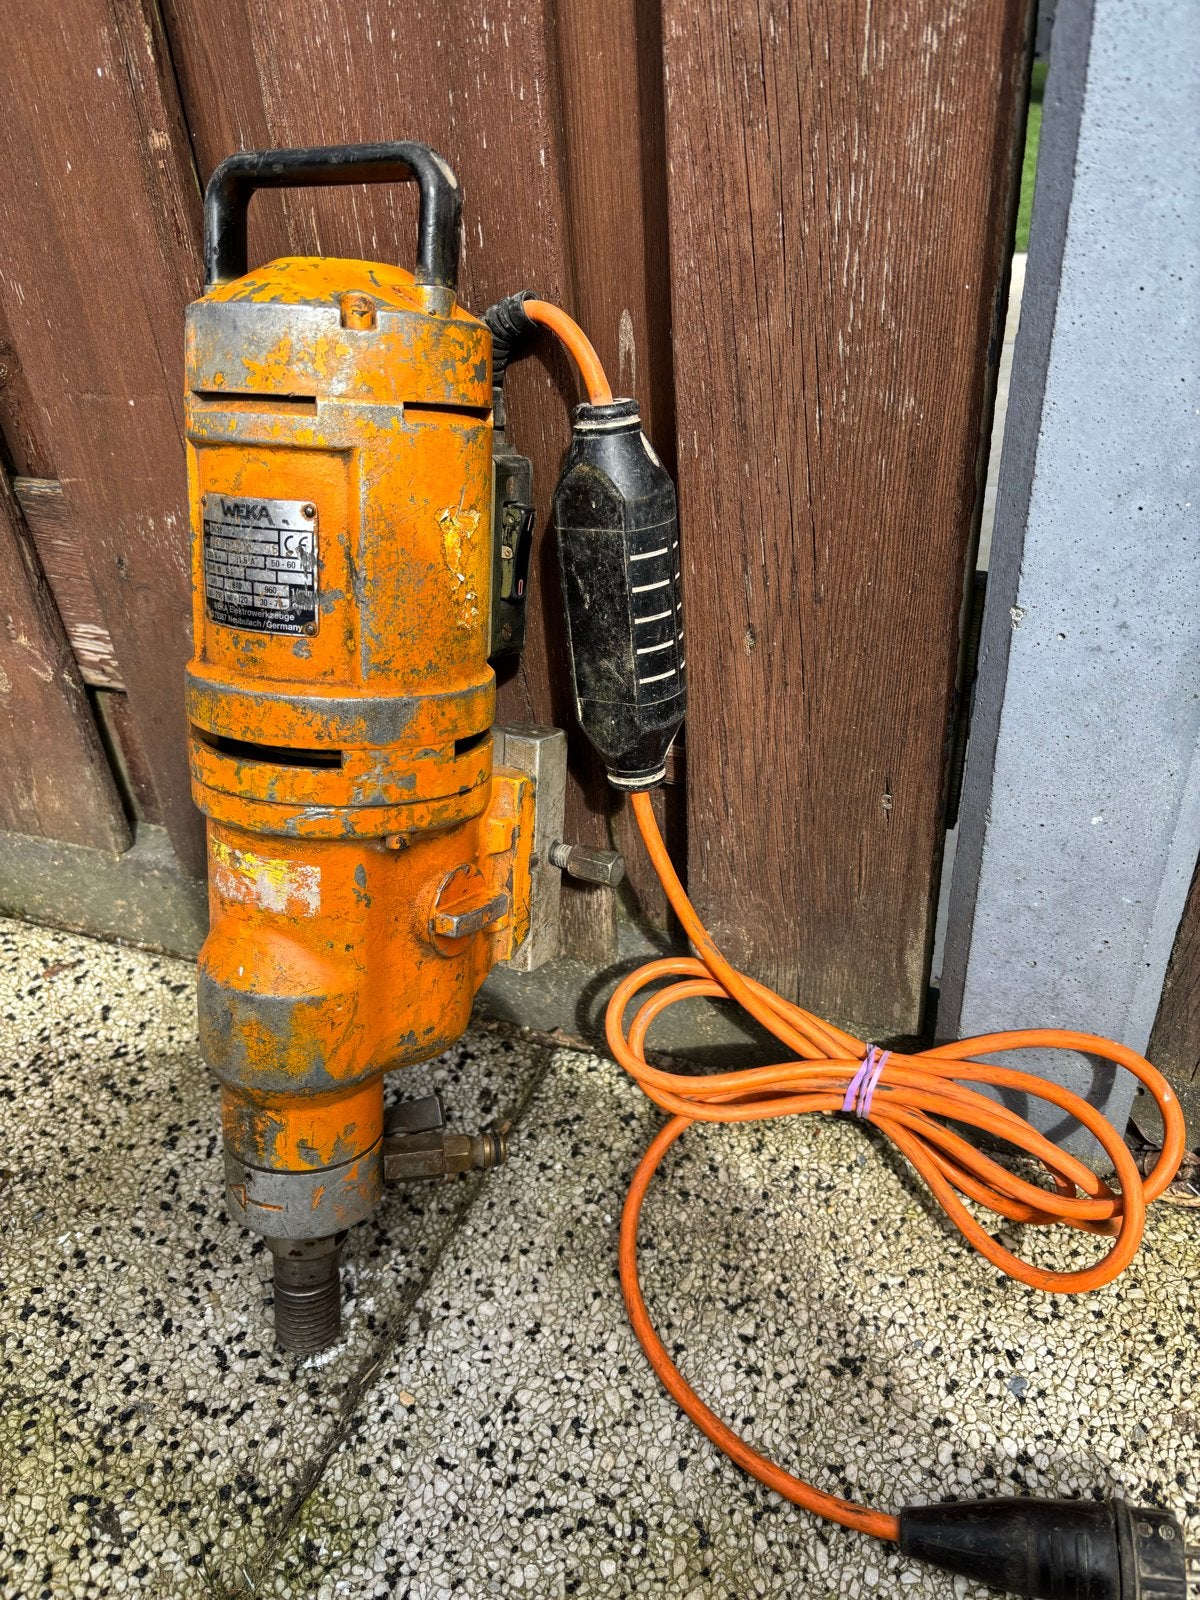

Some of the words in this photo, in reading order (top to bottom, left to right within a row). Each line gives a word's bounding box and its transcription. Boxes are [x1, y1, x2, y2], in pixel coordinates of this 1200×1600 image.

[220, 498, 276, 527] WEKA
[270, 560, 280, 568] 50
[287, 561, 296, 569] 60
[264, 585, 277, 594] 960
[229, 605, 296, 622] Elektrowerkzeuge
